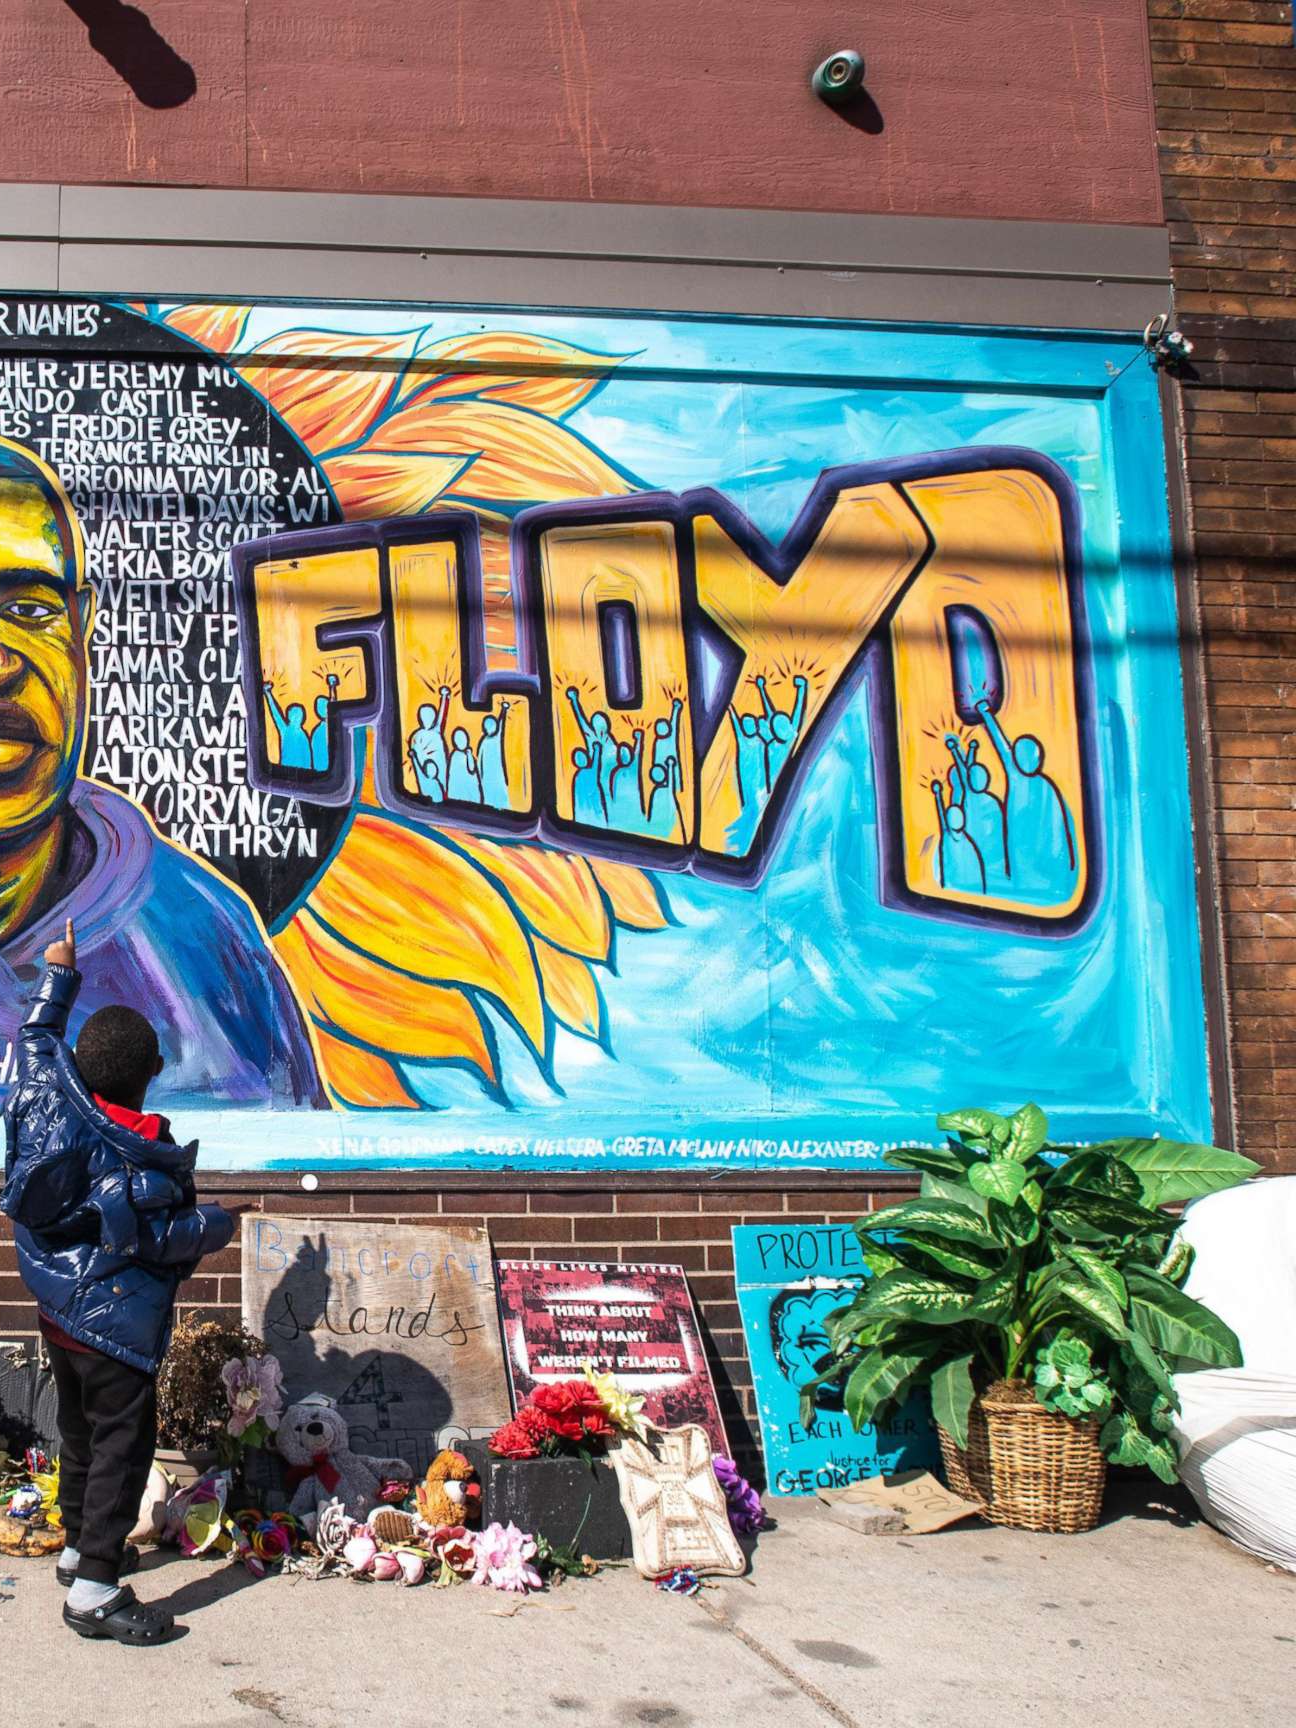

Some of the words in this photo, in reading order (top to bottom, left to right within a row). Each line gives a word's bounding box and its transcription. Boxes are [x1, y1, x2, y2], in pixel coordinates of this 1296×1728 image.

[16, 303, 100, 337] NAMES
[68, 361, 185, 390] JEREMY
[101, 389, 208, 418] CASTILE
[52, 412, 162, 442] FREDDIE
[169, 417, 241, 446] GREY
[33, 437, 147, 465] TERRANCE
[151, 441, 270, 468] FRANKLIN
[58, 463, 178, 494] BREONNA
[176, 466, 280, 496] TAYLOR
[72, 492, 194, 522] SHANTEL
[197, 494, 277, 523] DAVIS
[80, 520, 194, 551] WALTER
[85, 550, 165, 580] REKIA
[92, 610, 194, 649] SHELLY
[89, 646, 192, 687] JAMAR
[90, 680, 217, 721] TANISHA
[244, 460, 1096, 924] FLOYD
[90, 714, 199, 749] TARIKA
[91, 745, 188, 785] ALTON
[170, 822, 317, 859] KATHRYN
[612, 1136, 666, 1158] GRETA
[500, 1262, 552, 1271] BLACK
[560, 1263, 608, 1273] LIVES
[616, 1265, 680, 1275] MATTER
[545, 1305, 597, 1317] THINK
[599, 1306, 652, 1318] ABOUT
[560, 1330, 598, 1342] HOW
[601, 1331, 648, 1343] MANY
[537, 1354, 613, 1368] WEREN'T
[616, 1355, 681, 1369] FILMED
[337, 1355, 403, 1429] 4
